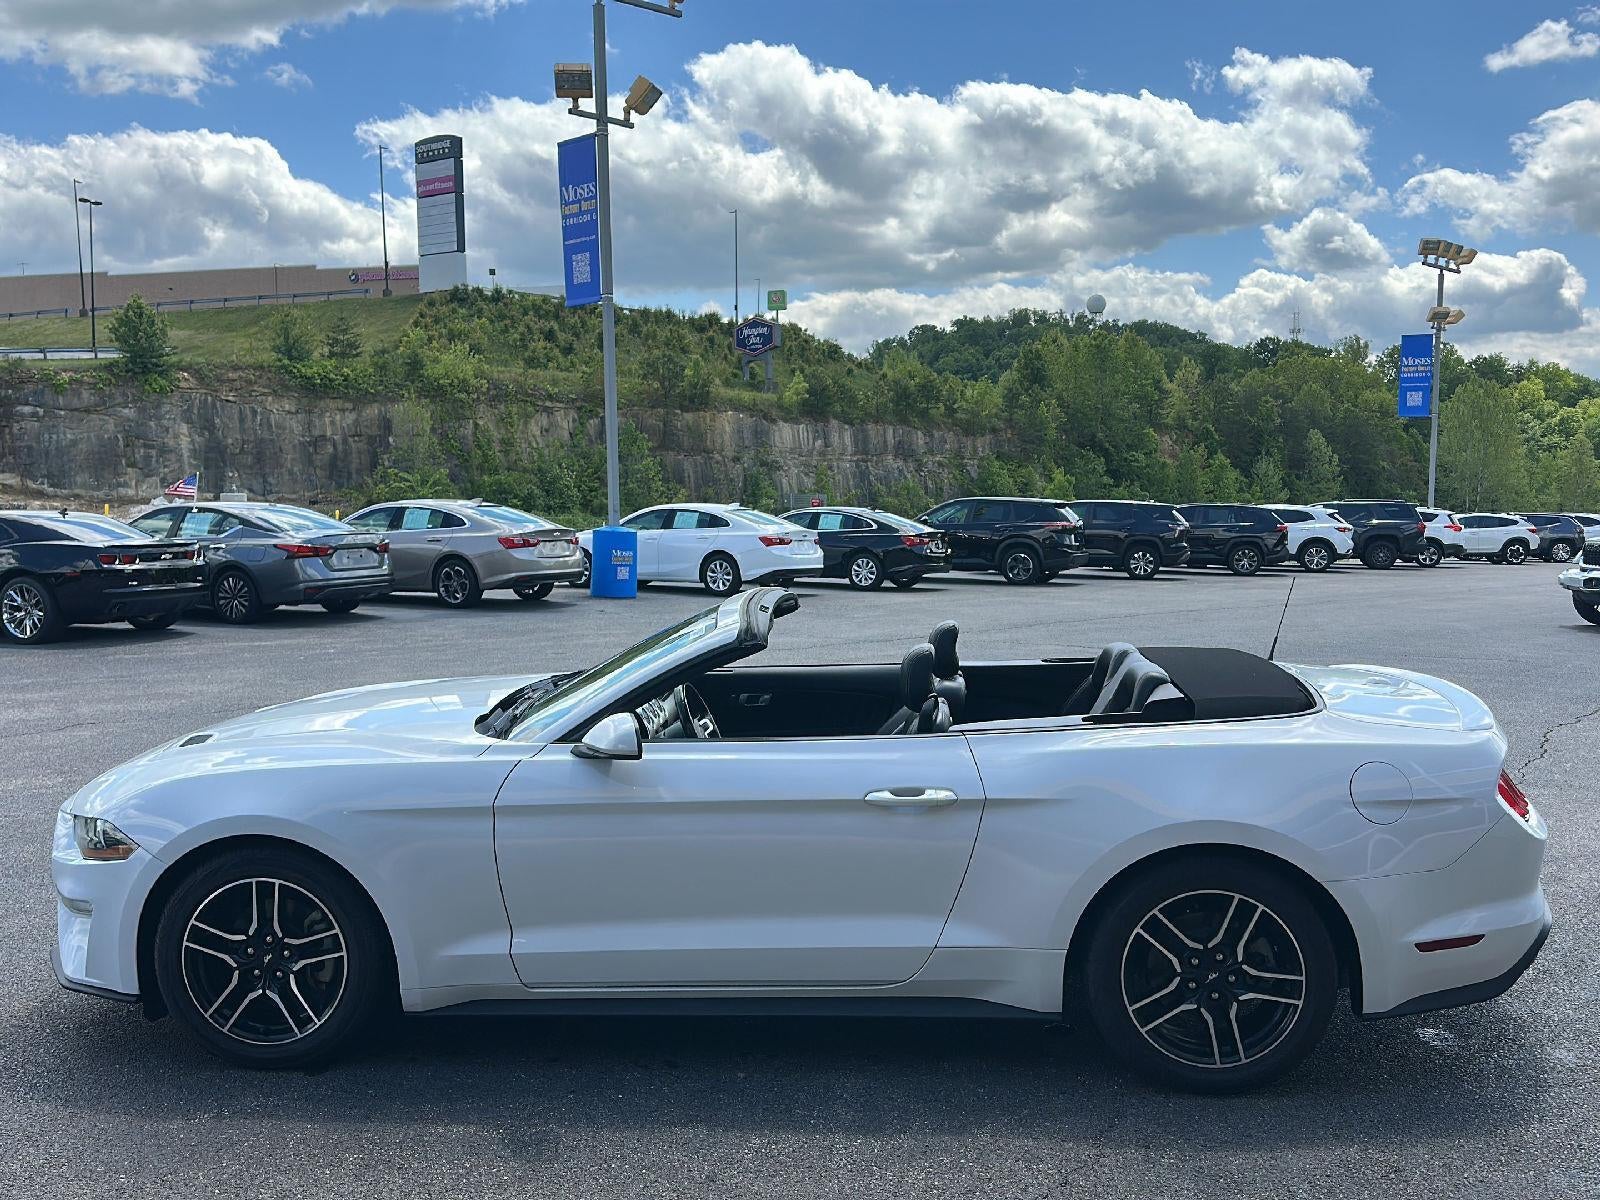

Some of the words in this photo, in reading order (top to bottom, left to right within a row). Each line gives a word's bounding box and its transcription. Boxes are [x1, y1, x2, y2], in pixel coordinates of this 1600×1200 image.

[416, 139, 451, 153] SOUTHRIDGE
[561, 182, 596, 203] MOSES
[562, 214, 591, 226] CORRIDOR
[739, 326, 770, 338] Hampton
[1402, 357, 1431, 366] MOSES
